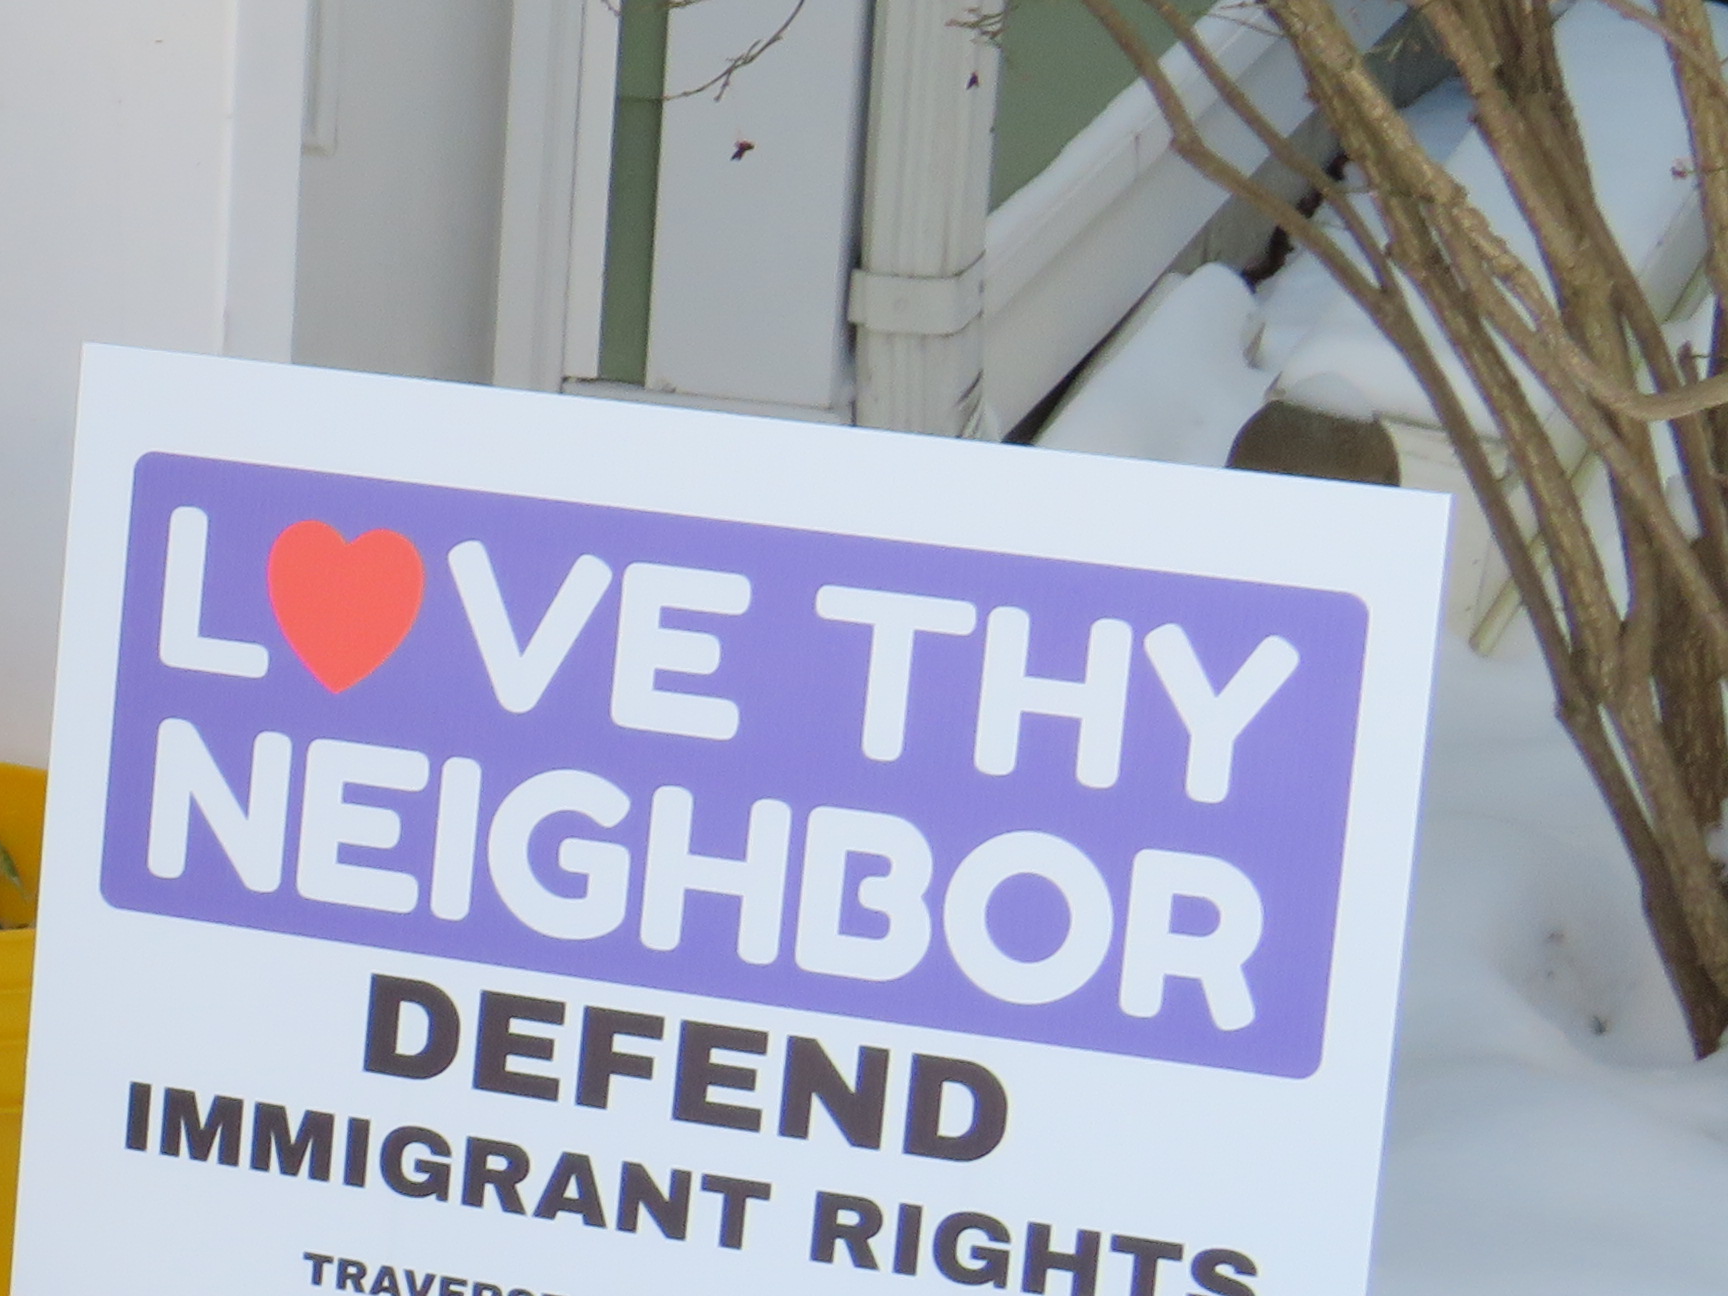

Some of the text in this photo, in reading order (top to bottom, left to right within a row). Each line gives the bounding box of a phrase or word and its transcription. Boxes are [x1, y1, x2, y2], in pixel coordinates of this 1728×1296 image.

[814, 584, 1300, 805] THY
[146, 717, 1263, 1032] NEIGHBOR
[125, 1081, 771, 1250] IMMIGRANT
[363, 973, 1008, 1163] DEFEND
